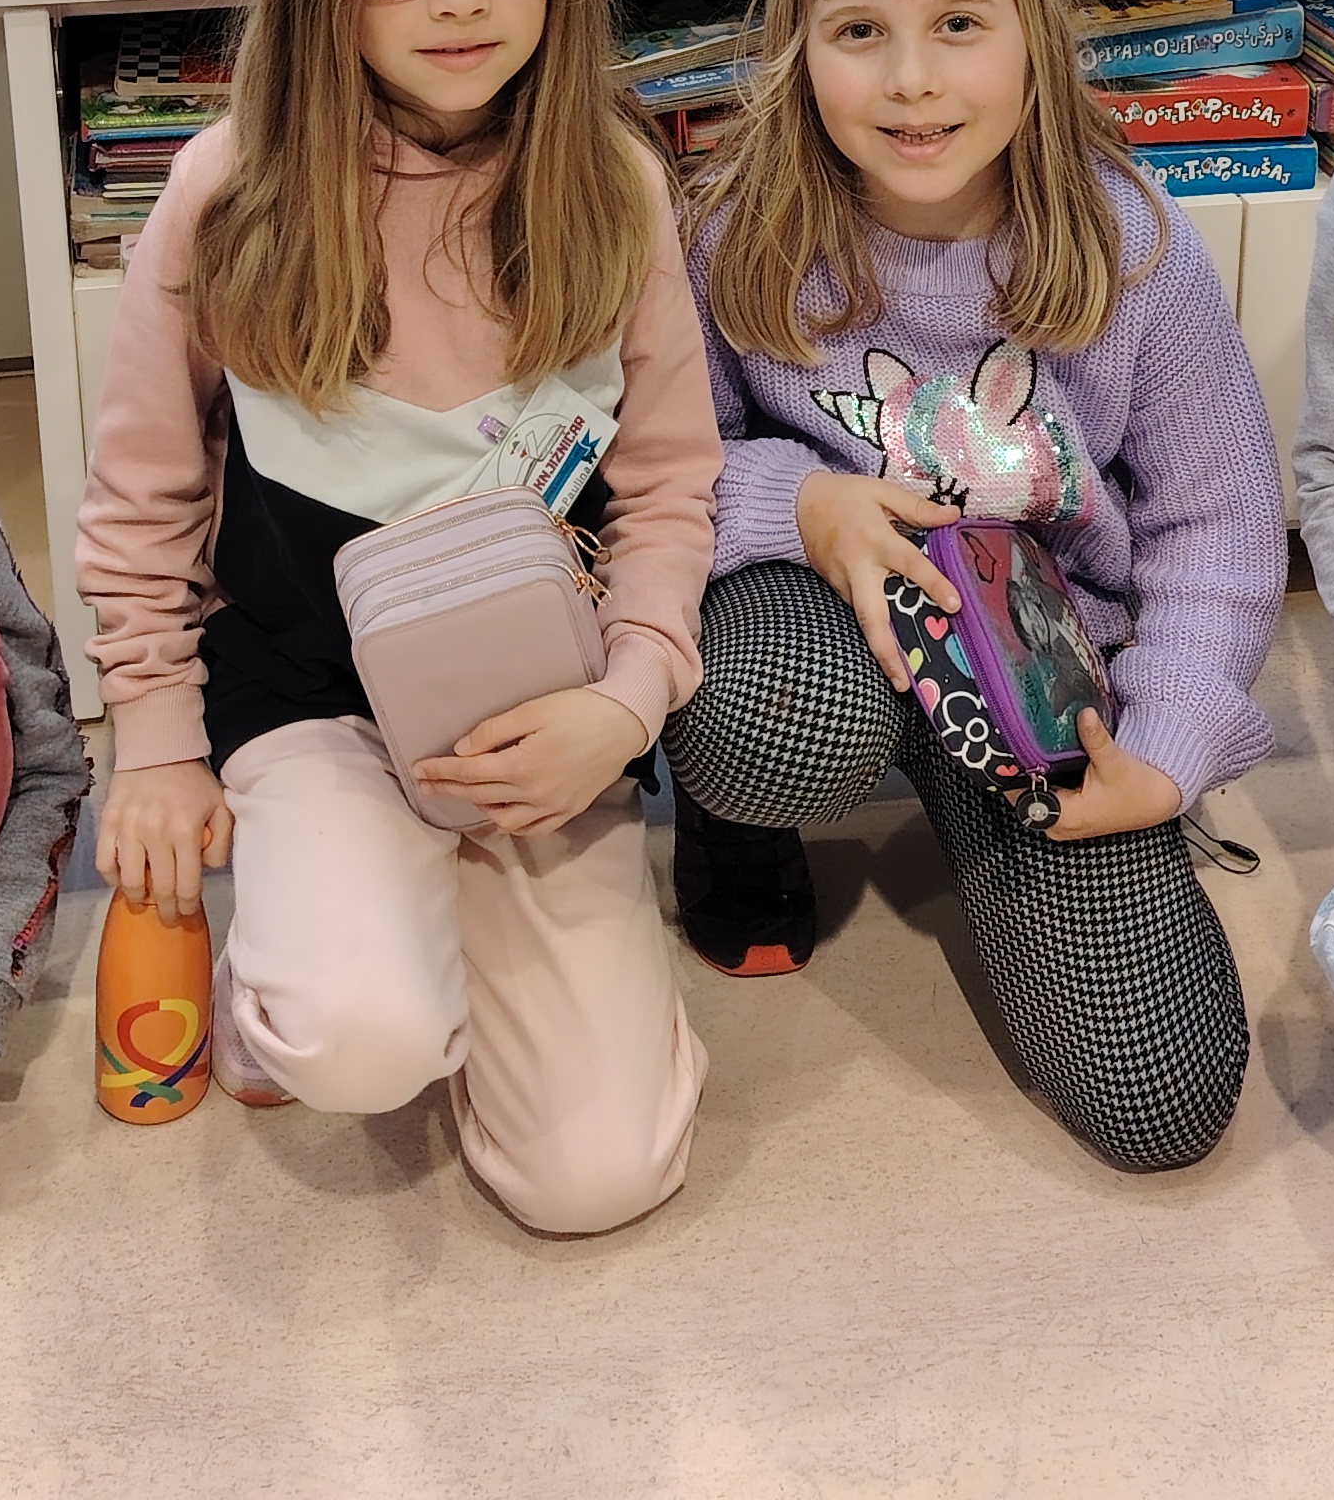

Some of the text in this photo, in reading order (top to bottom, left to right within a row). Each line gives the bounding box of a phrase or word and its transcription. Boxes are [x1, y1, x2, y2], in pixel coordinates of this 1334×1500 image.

[1144, 98, 1281, 126] OSJETI POSLUŠAJ
[1216, 157, 1291, 184] POSLUŠAJ
